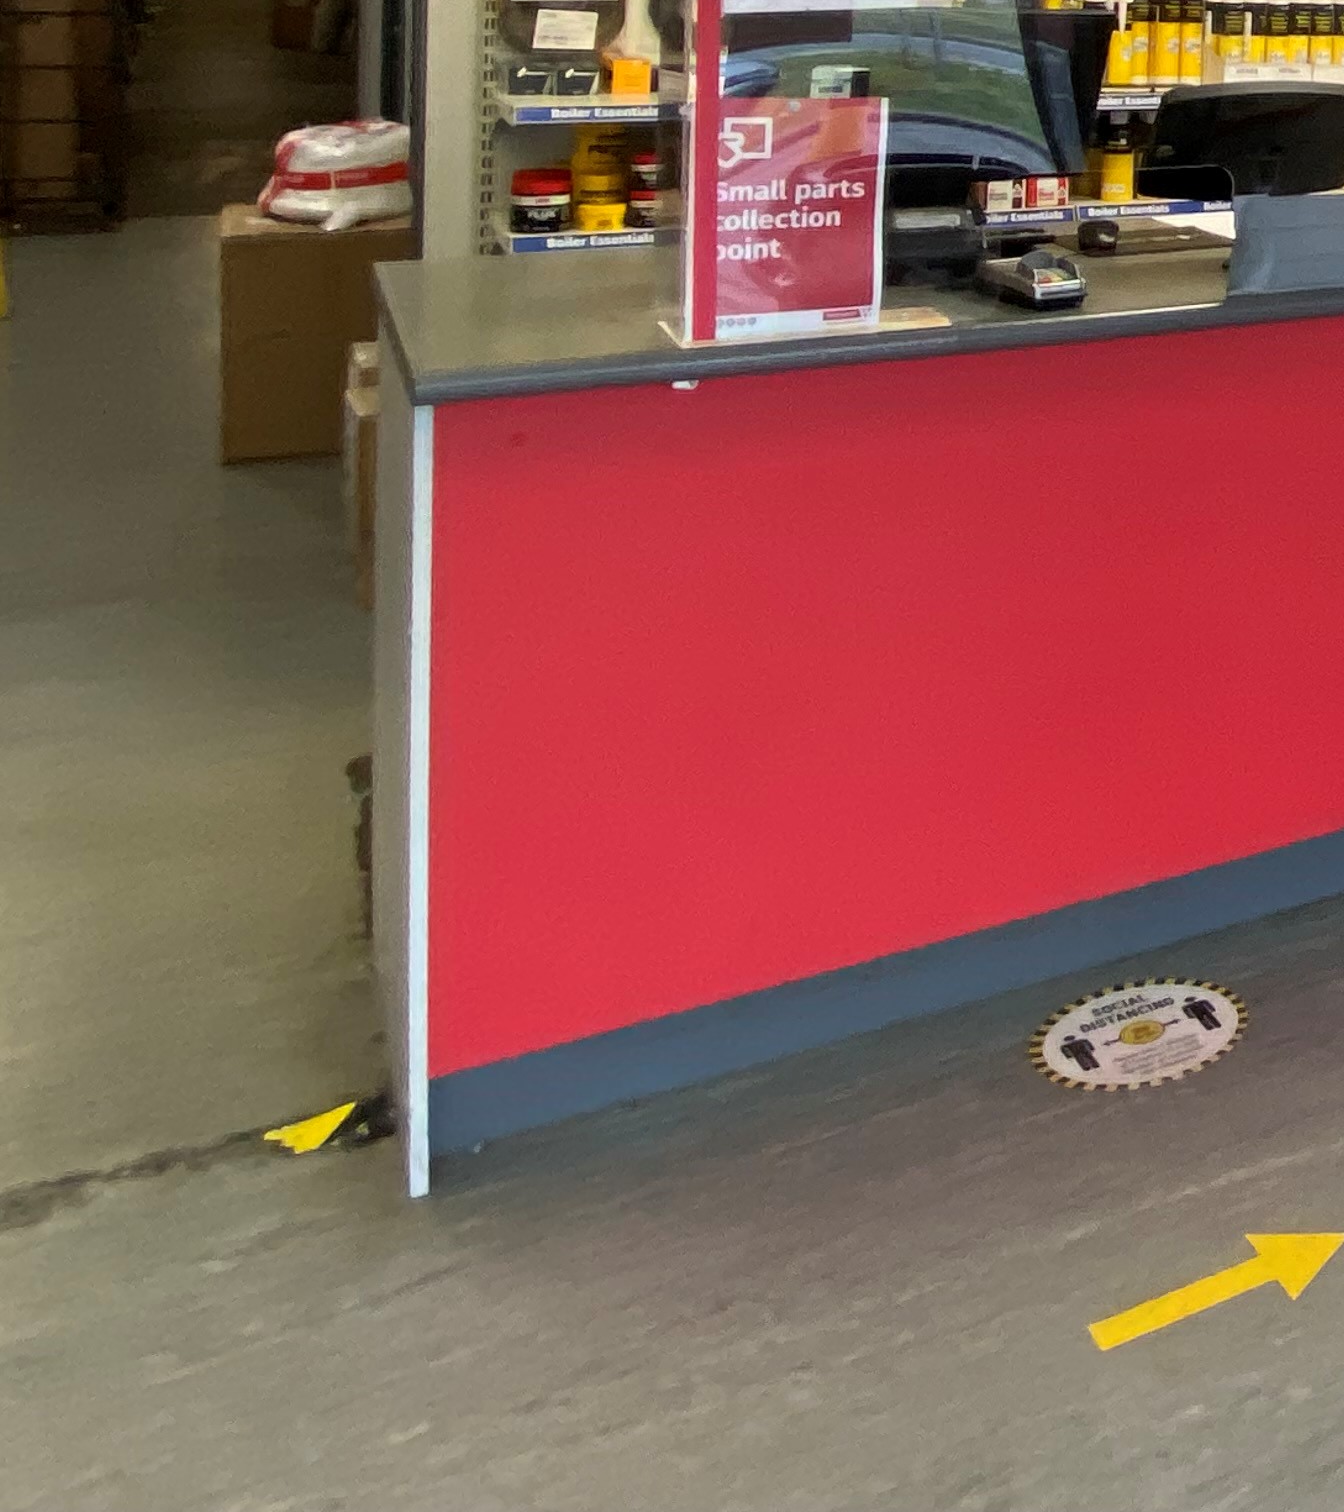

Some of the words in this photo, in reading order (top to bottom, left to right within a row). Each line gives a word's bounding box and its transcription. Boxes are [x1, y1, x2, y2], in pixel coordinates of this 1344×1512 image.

[717, 179, 787, 201] Small
[794, 179, 865, 204] parts
[1079, 997, 1175, 1033] DISTANCING
[1091, 994, 1147, 1017] SOCIAL
